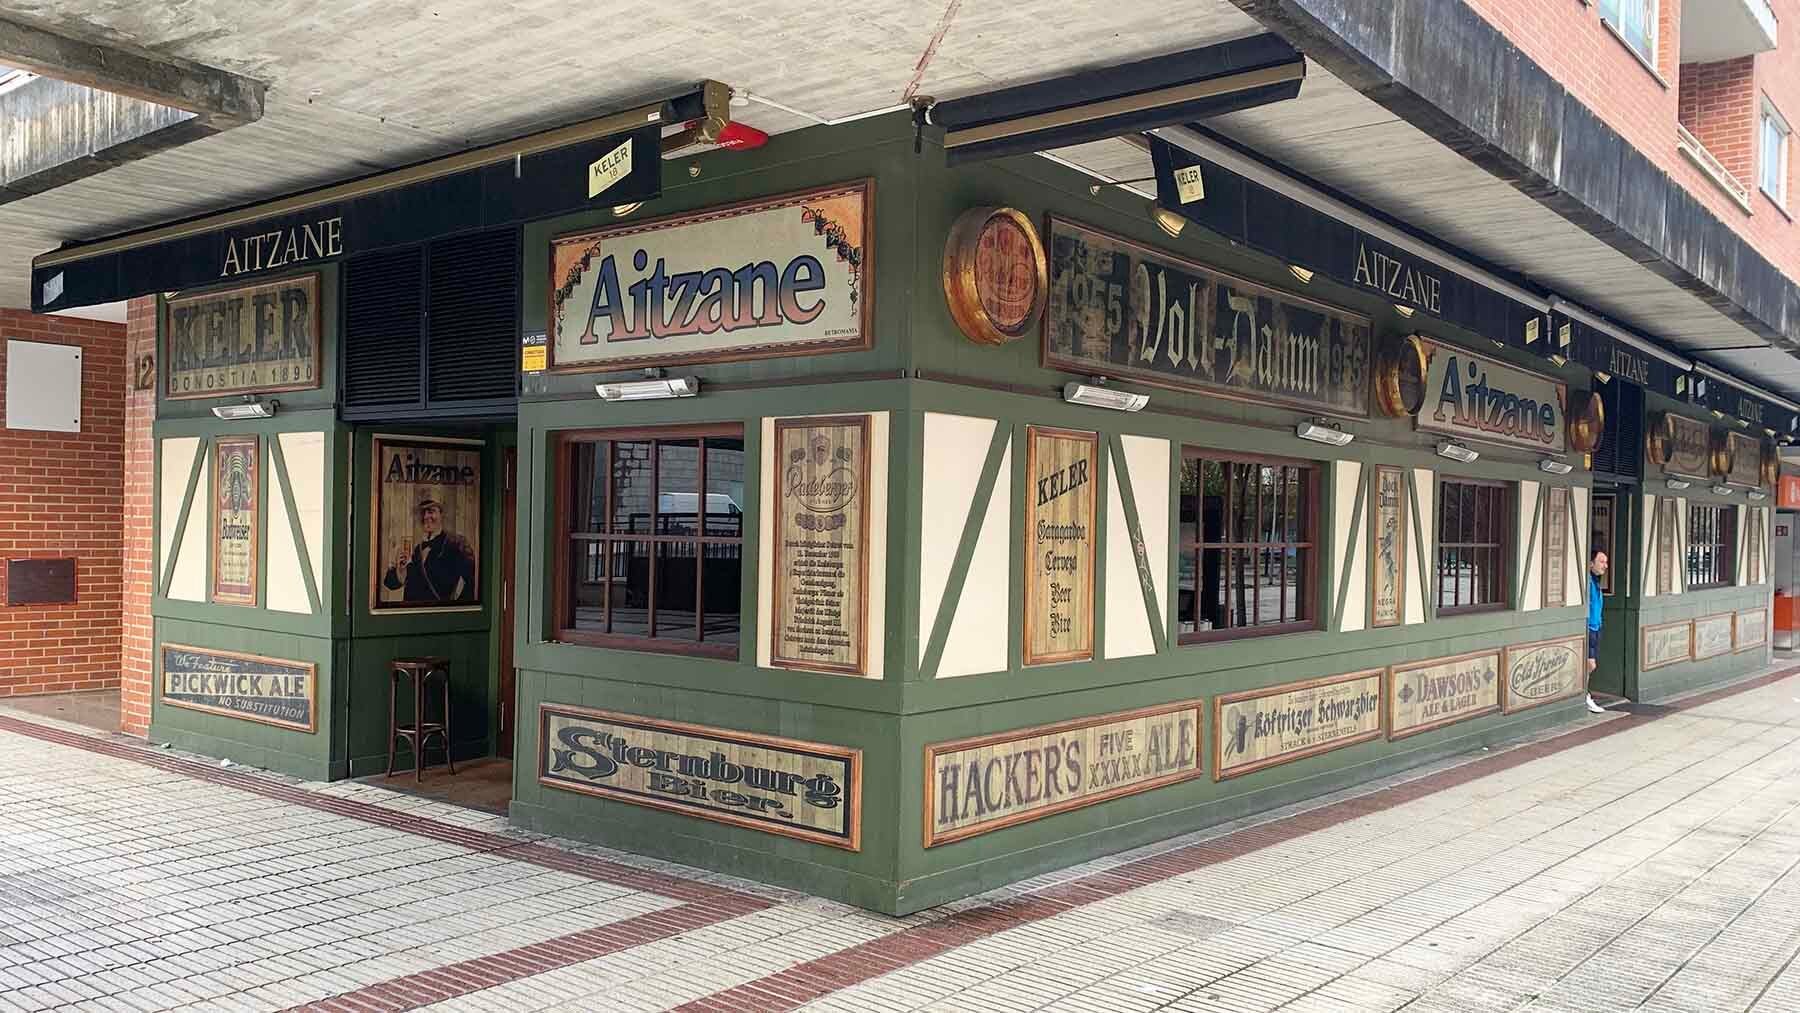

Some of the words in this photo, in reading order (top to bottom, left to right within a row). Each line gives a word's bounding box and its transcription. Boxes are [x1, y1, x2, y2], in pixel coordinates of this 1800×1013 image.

[594, 147, 628, 176] KELER
[220, 217, 343, 277] AITZANE
[1353, 239, 1441, 314] AITZANE
[580, 248, 826, 346] Aitzane
[174, 288, 312, 370] KELER
[172, 370, 257, 392] DONOSTIA
[1609, 344, 1649, 385] AITZANE
[1433, 356, 1556, 444] Aitzane
[384, 453, 475, 486] Aitzane
[1037, 458, 1089, 507] KELER
[1050, 583, 1072, 608] Beer
[170, 673, 263, 697] PICKWICK
[269, 676, 305, 698] ALE
[1415, 665, 1481, 704] DAWSON'S
[218, 696, 232, 707] NO
[236, 699, 304, 719] SUBSTITUTION
[1422, 701, 1441, 719] ALE
[1442, 700, 1448, 713] &
[1100, 730, 1134, 757] FIVE
[551, 726, 842, 809] Sternburg
[937, 736, 1083, 825] HACKER'S
[1143, 719, 1194, 775] ALE
